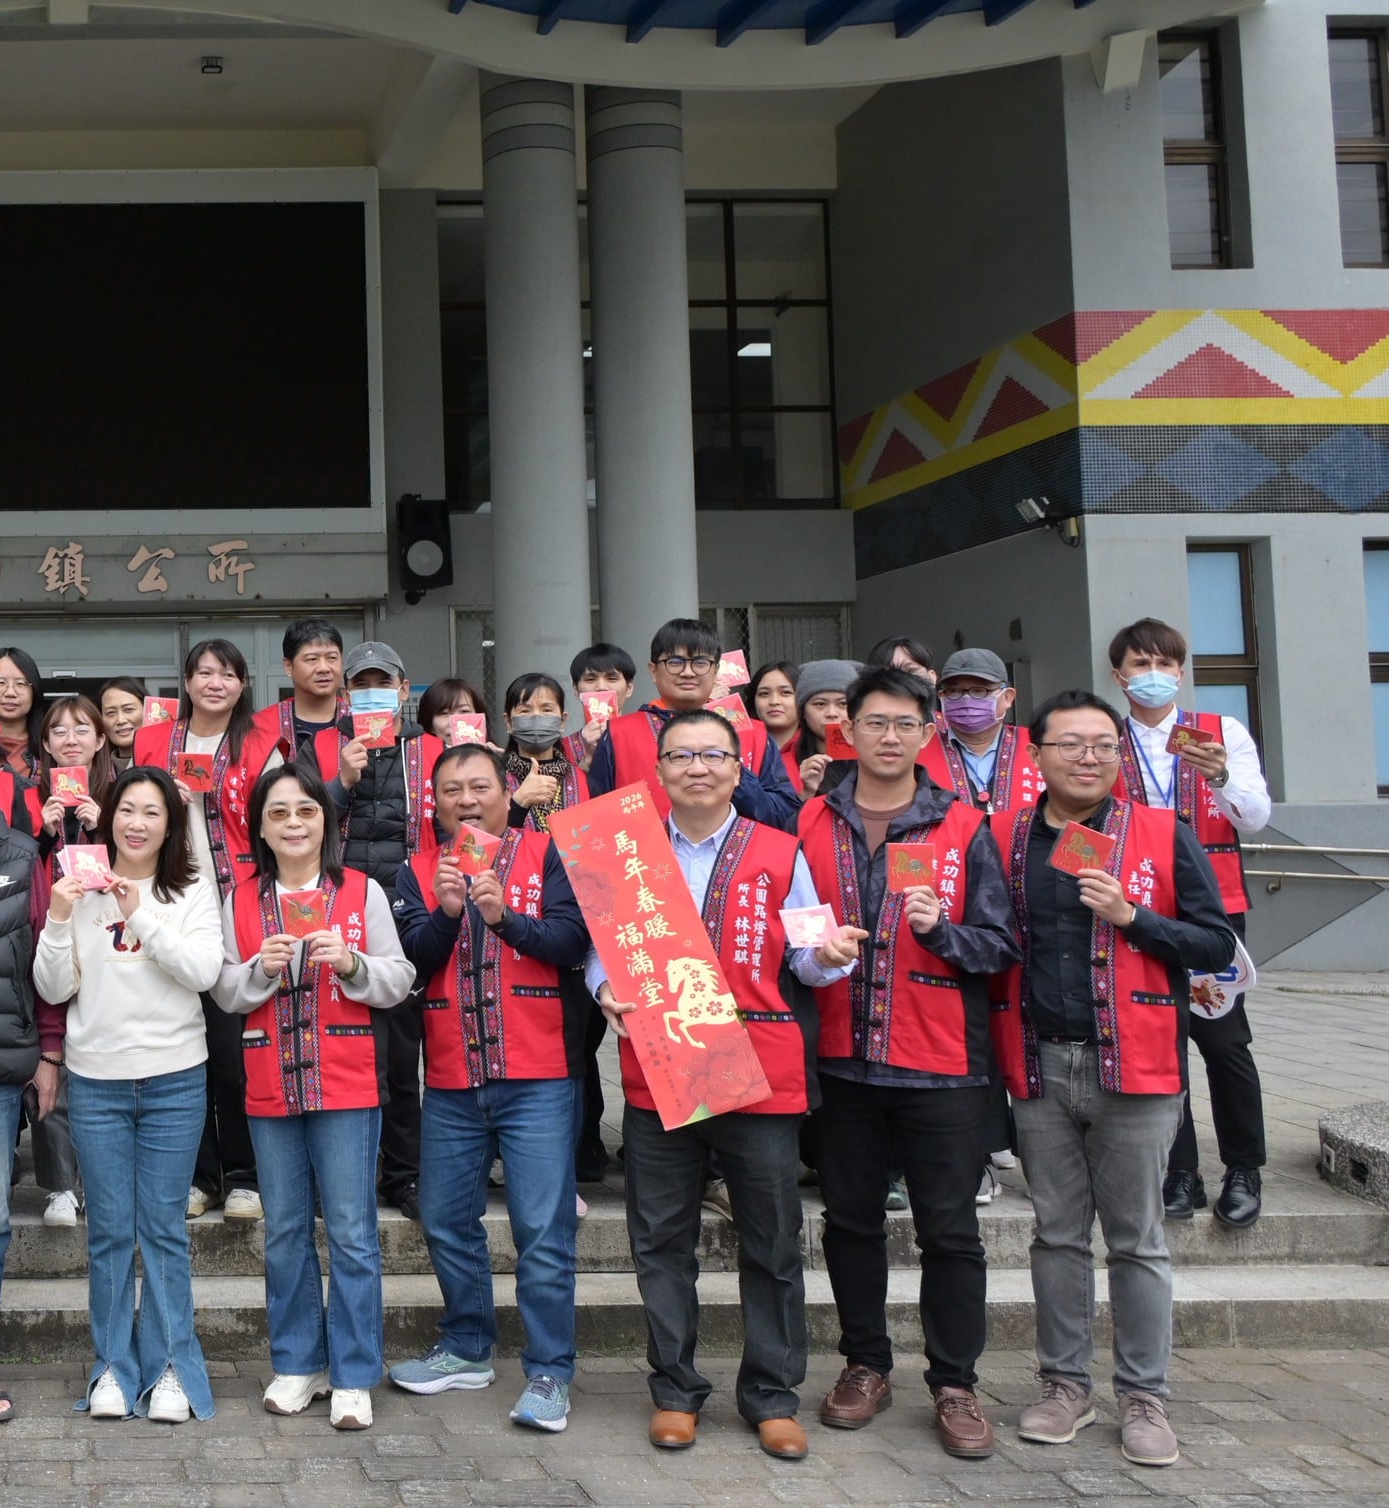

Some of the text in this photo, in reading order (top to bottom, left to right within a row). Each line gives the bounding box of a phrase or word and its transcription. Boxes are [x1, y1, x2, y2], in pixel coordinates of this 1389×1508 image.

[620, 792, 642, 807] 2026
[615, 830, 677, 939] 馬年春暖
[737, 883, 750, 907] 所長
[940, 848, 960, 920] 成功鎮公
[1128, 871, 1141, 895] 主任
[751, 873, 771, 983] 公園路燈管理所
[615, 922, 665, 1008] 福滿堂
